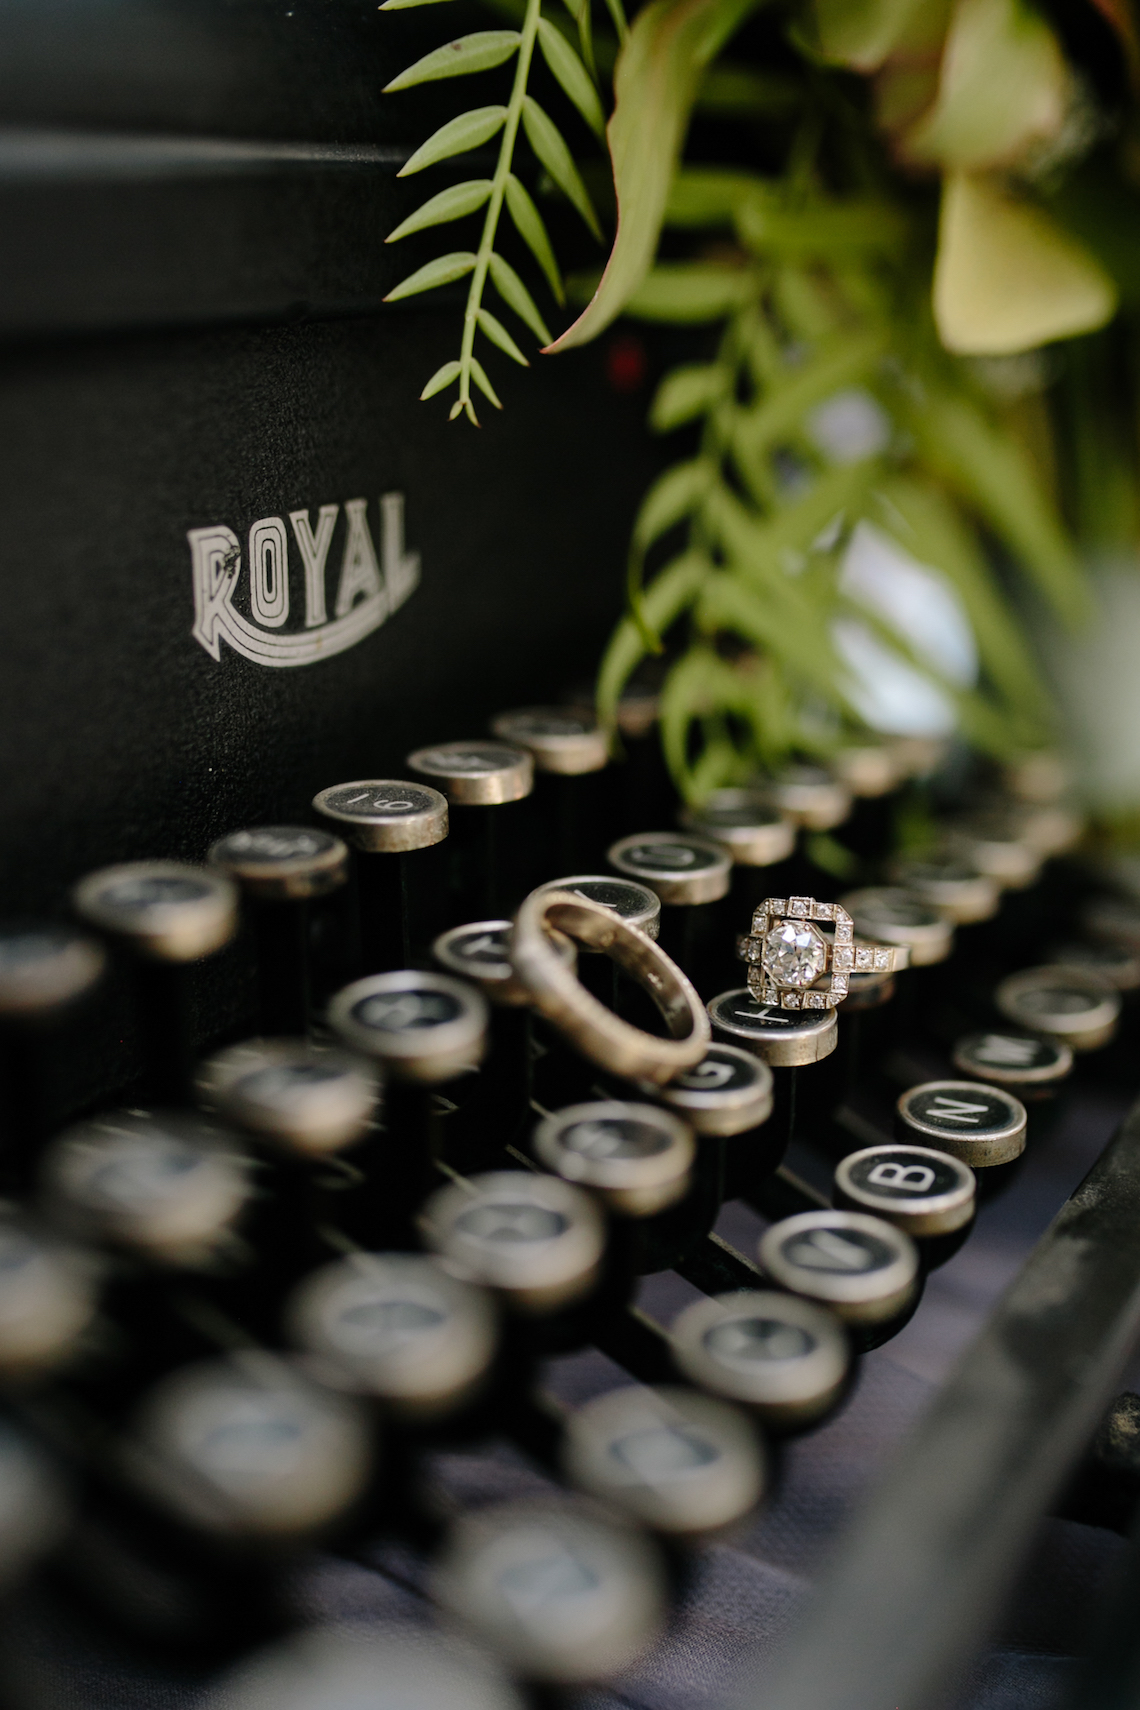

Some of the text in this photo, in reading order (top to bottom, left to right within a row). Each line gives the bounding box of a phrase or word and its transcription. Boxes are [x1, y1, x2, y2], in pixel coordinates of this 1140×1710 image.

[186, 490, 421, 668] ROYAL
[925, 1096, 990, 1124] N
[867, 1162, 936, 1193] B
